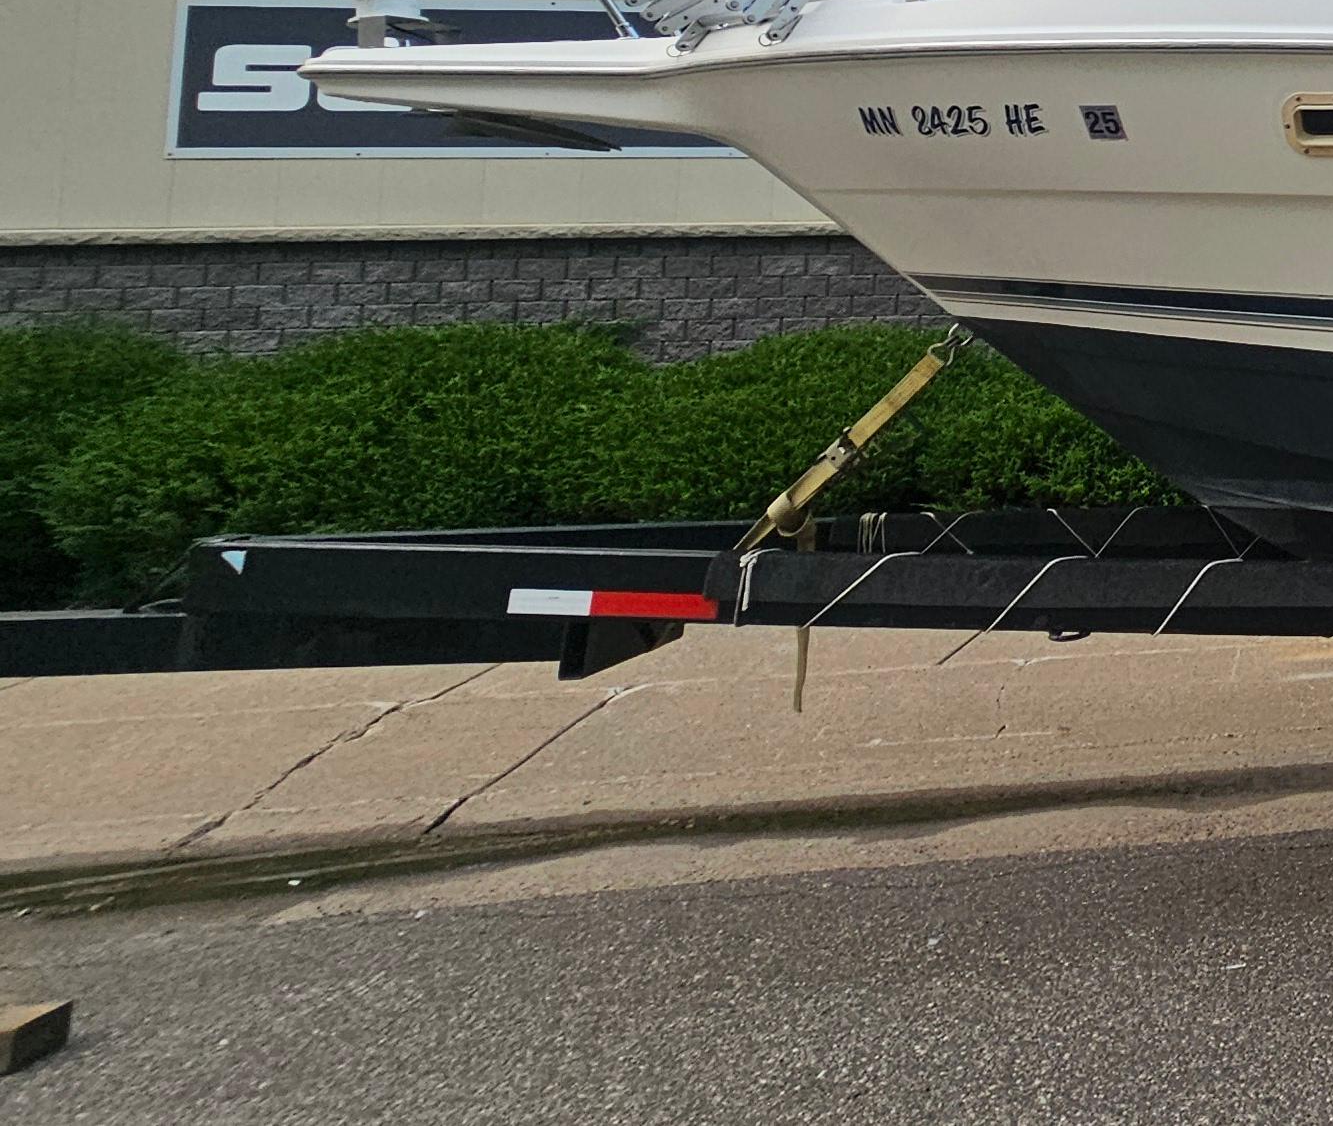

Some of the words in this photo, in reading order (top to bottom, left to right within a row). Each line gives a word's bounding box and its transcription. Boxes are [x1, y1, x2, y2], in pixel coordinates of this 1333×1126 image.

[858, 105, 902, 136] MN
[911, 104, 990, 137] 2425
[1004, 103, 1048, 137] HE
[1084, 111, 1121, 134] 25
